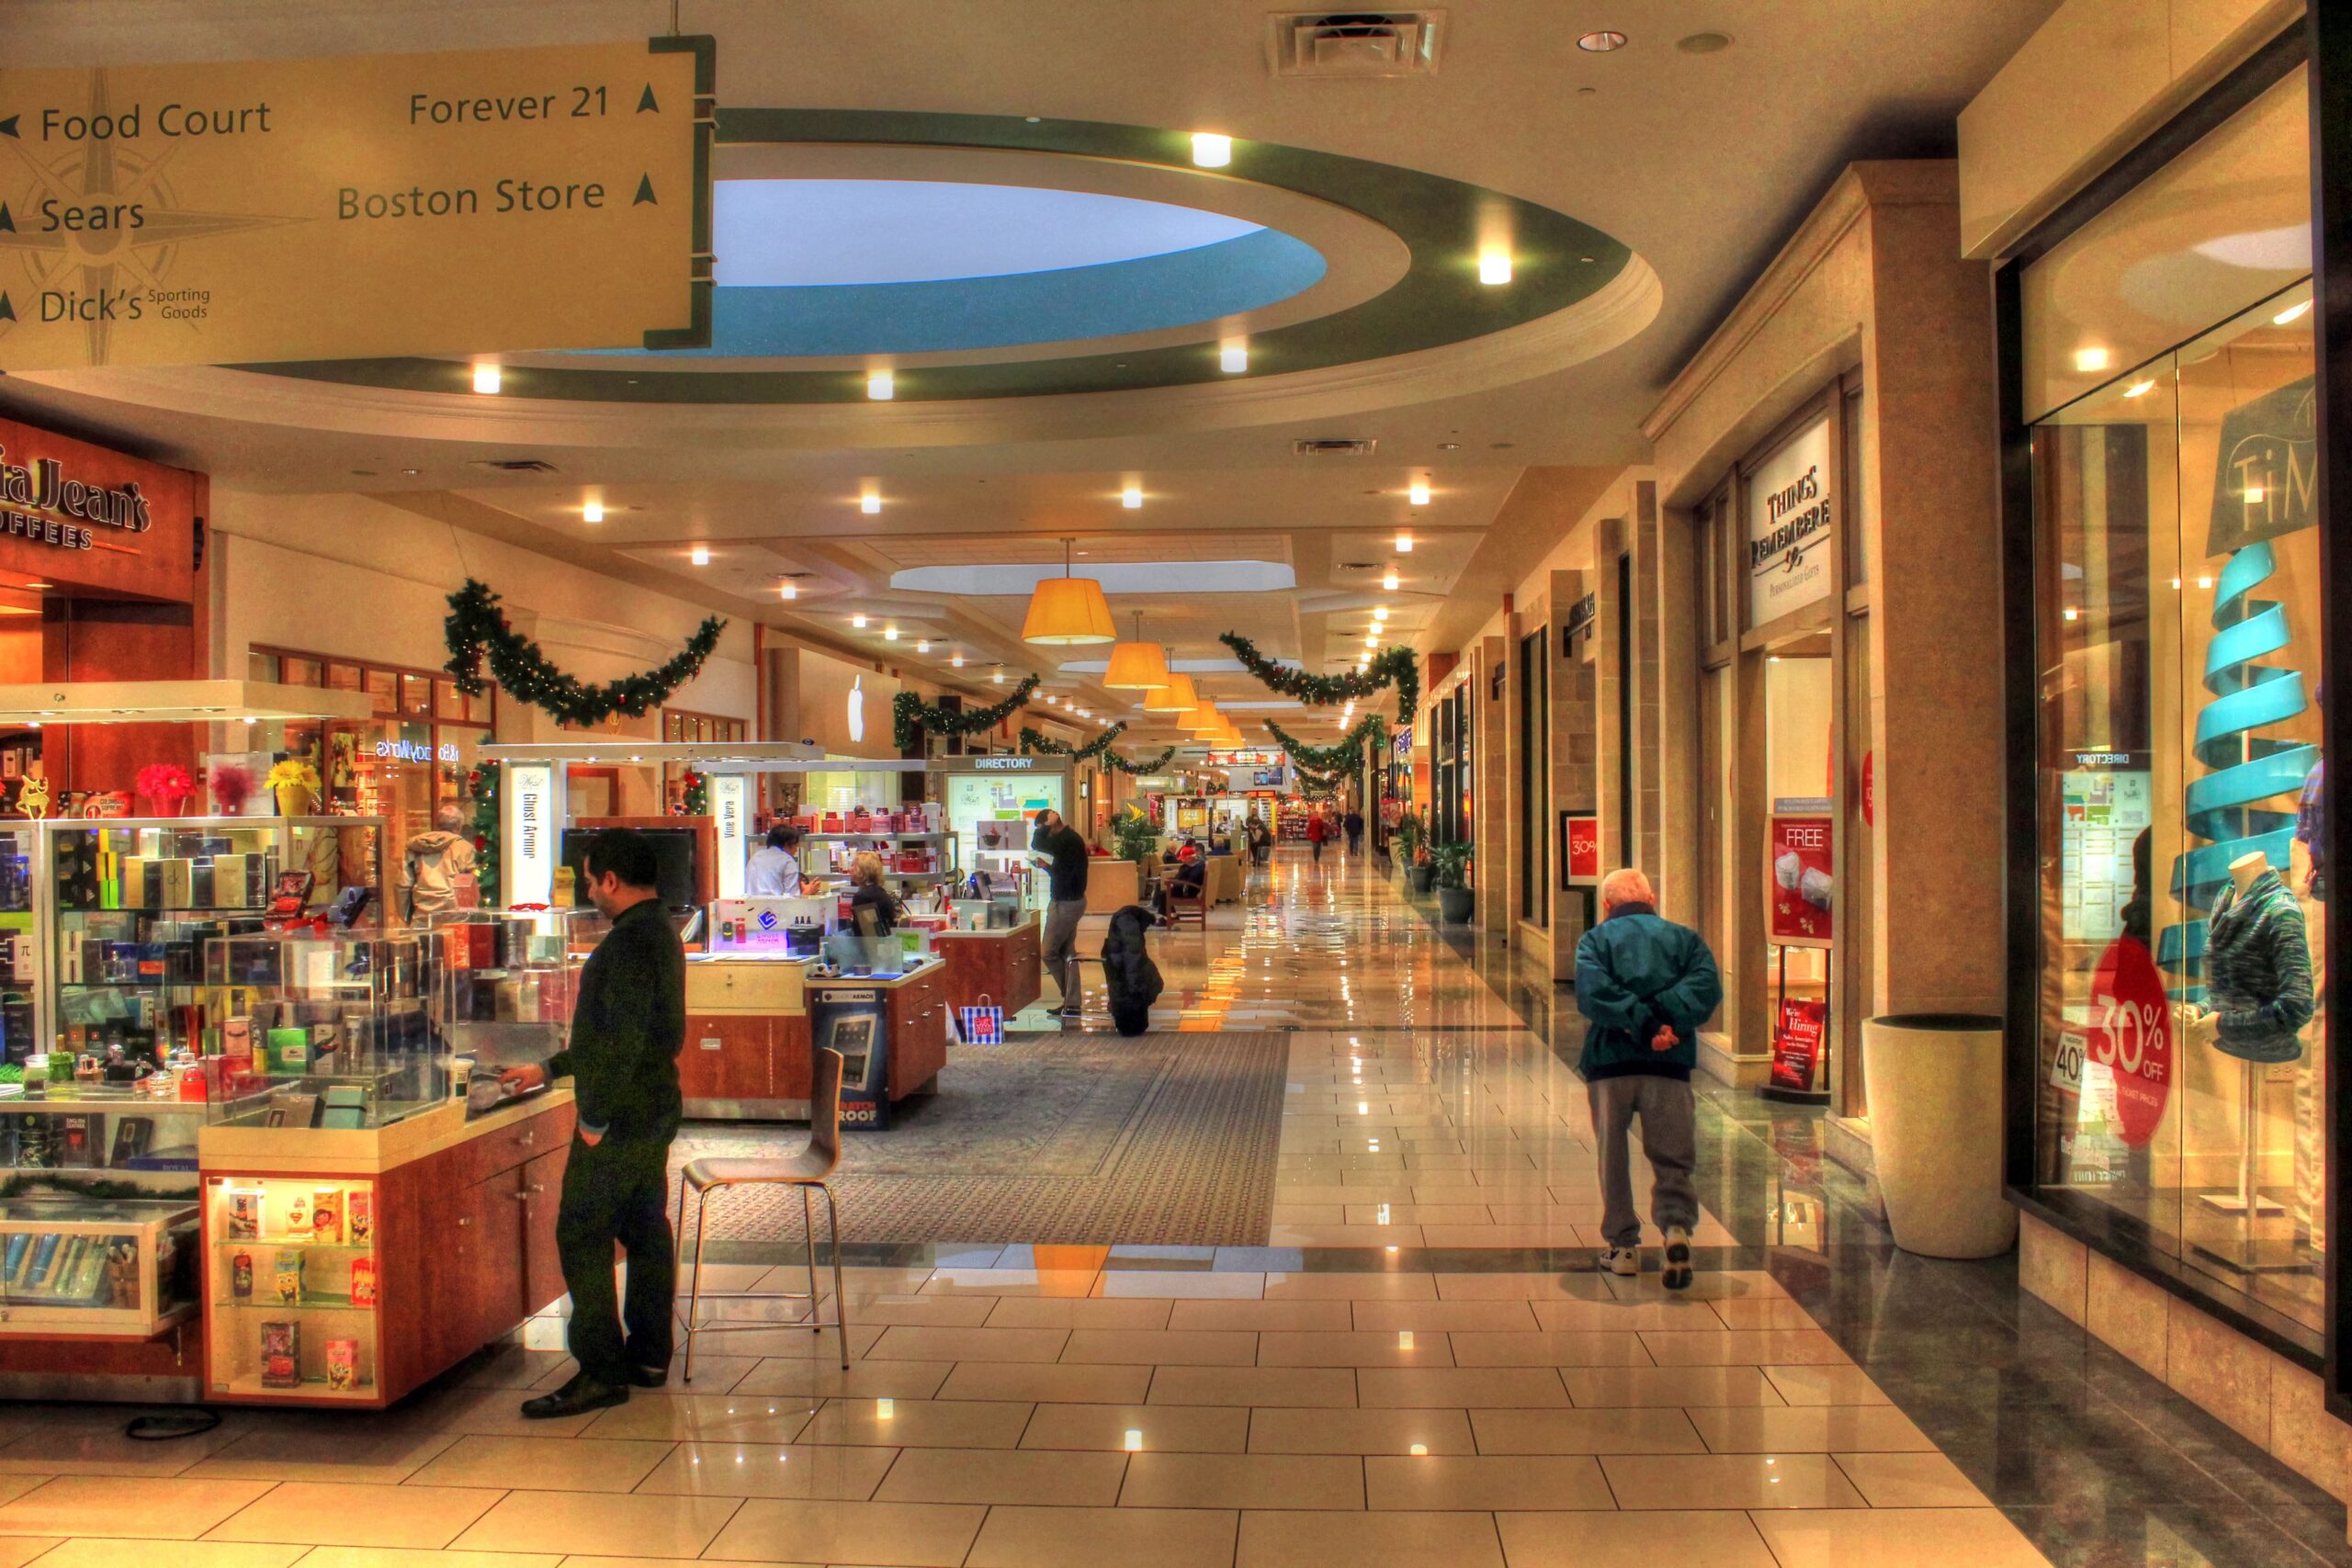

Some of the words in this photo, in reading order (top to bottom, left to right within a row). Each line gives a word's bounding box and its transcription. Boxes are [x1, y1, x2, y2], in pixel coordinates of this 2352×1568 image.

[410, 94, 556, 124] Forever
[571, 85, 607, 117] 21
[42, 105, 141, 141] Food
[158, 102, 271, 137] Court
[338, 186, 478, 220] Boston
[496, 179, 605, 213] Store
[41, 199, 144, 232] Sears
[41, 288, 141, 322] Dick's
[148, 288, 210, 305] Sporting
[161, 305, 208, 320] Goods
[1750, 493, 1830, 570] REMEMBERE
[975, 758, 1034, 769] DIRECTORY
[523, 793, 537, 821] Ghost
[724, 800, 735, 819] Vera
[724, 821, 735, 839] Vine
[1786, 829, 1824, 847] FREE
[523, 826, 537, 859] Armor
[1789, 1017, 1818, 1037] Hiring
[2143, 1059, 2164, 1082] OFF
[839, 1110, 876, 1121] ROOF
